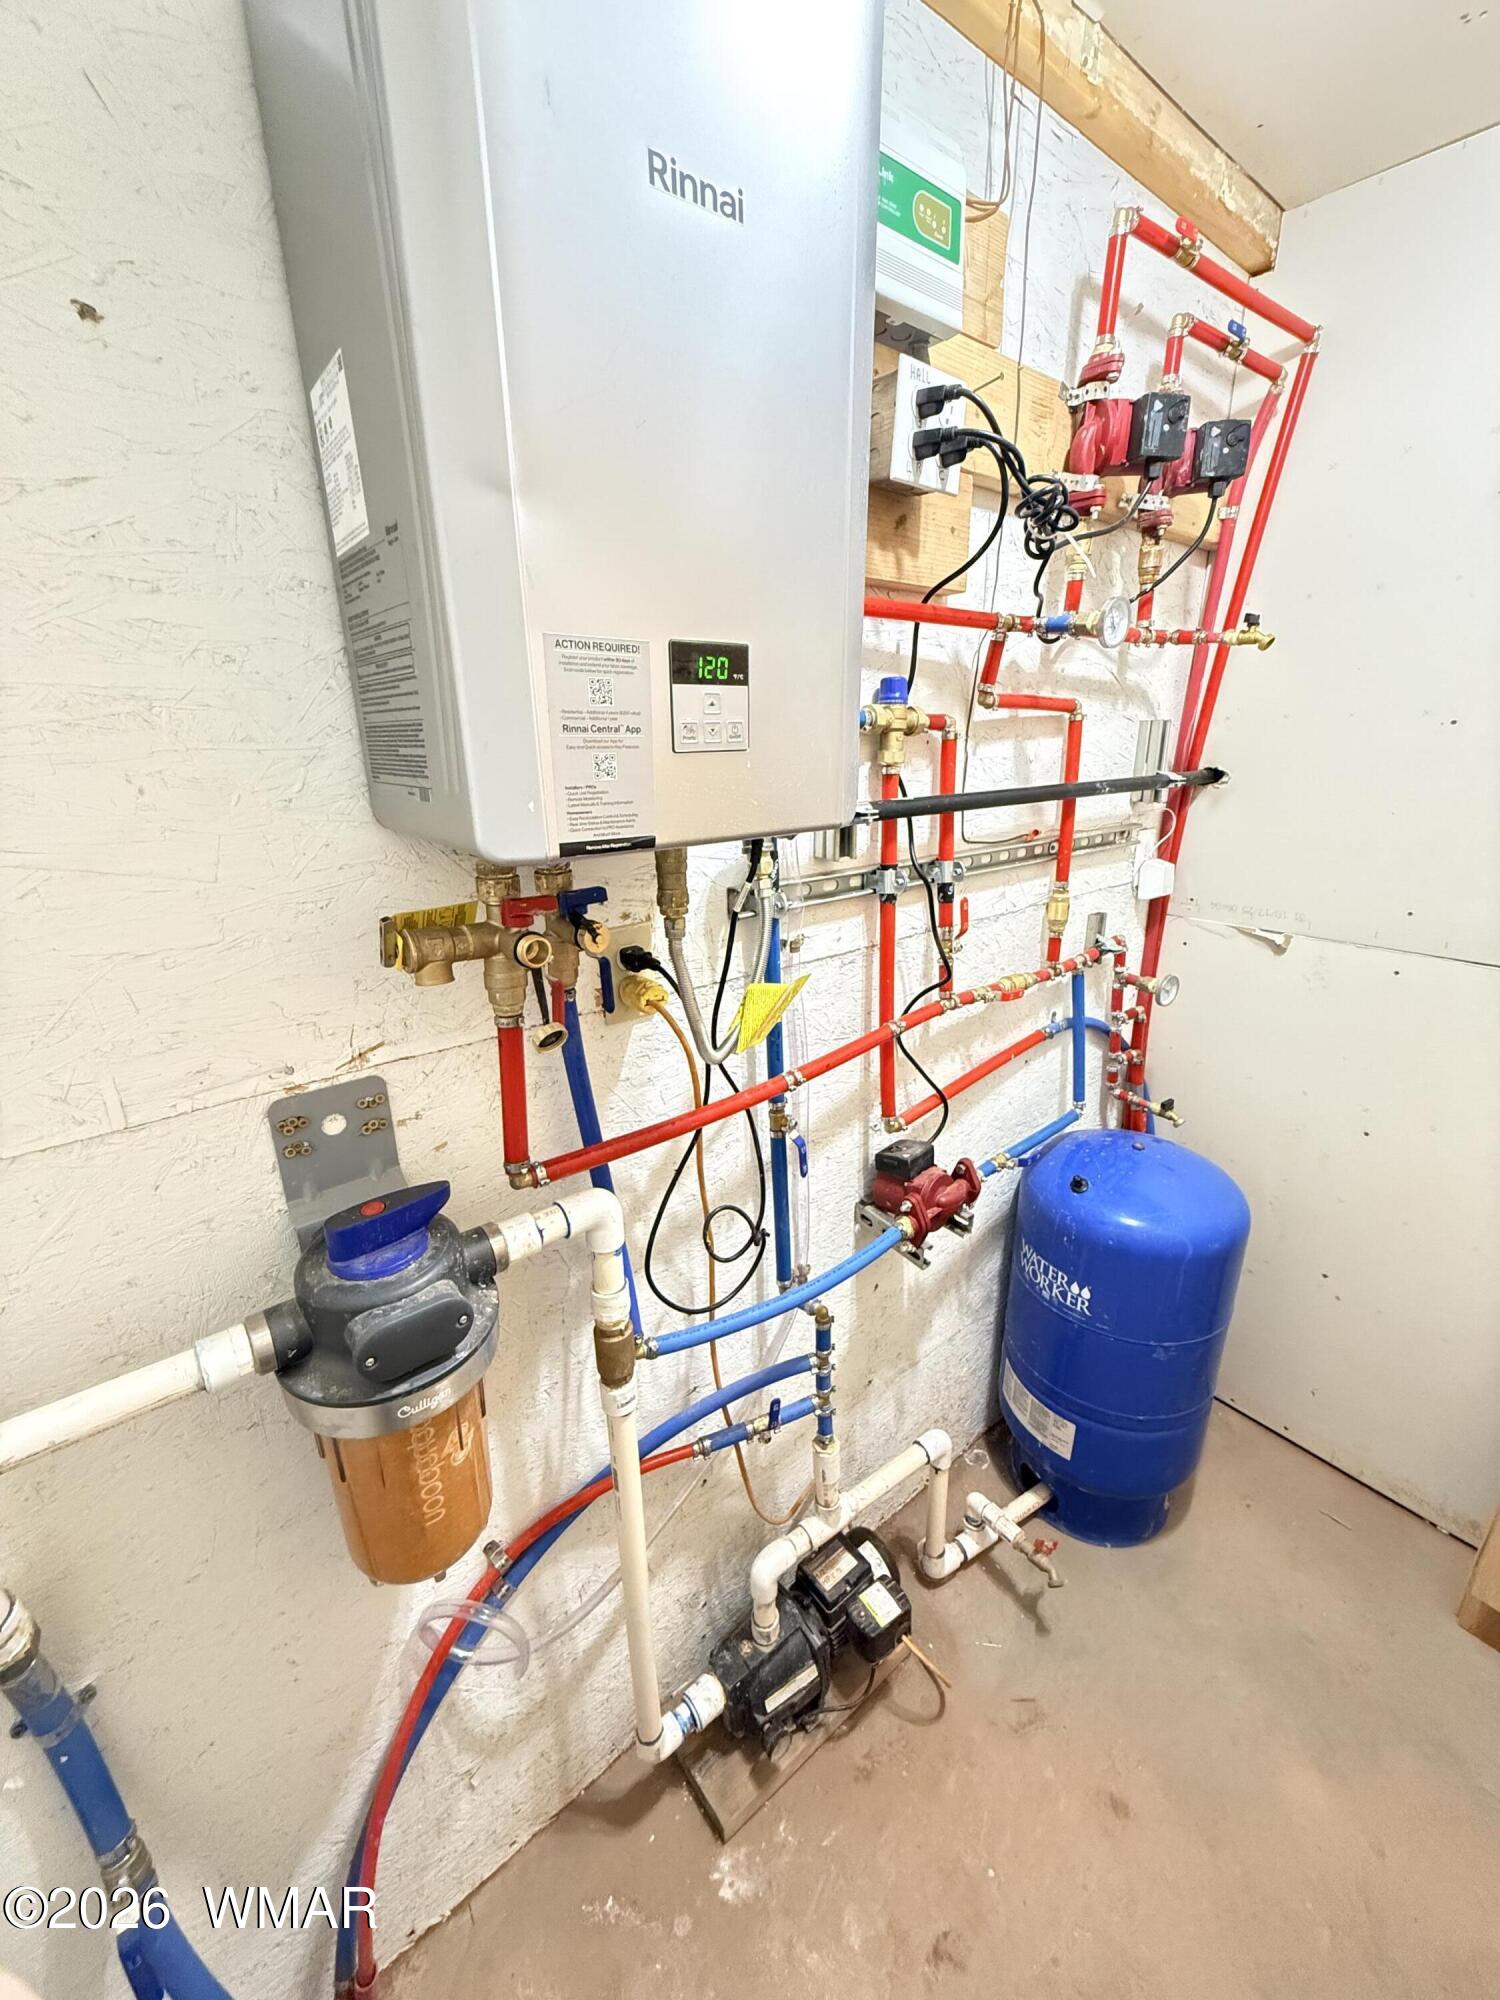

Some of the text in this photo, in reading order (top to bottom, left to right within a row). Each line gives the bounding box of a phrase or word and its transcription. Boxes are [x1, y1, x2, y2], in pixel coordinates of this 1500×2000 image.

[646, 146, 745, 225] Rinnai
[909, 363, 931, 384] HALL
[555, 639, 640, 654] ACTION REQUIRED!
[697, 655, 729, 680] 120
[562, 723, 589, 733] Rinnai
[625, 724, 642, 735] App
[1021, 1236, 1070, 1293] WATER
[1020, 1250, 1093, 1317] WORKER
[397, 1386, 452, 1418] Culligan
